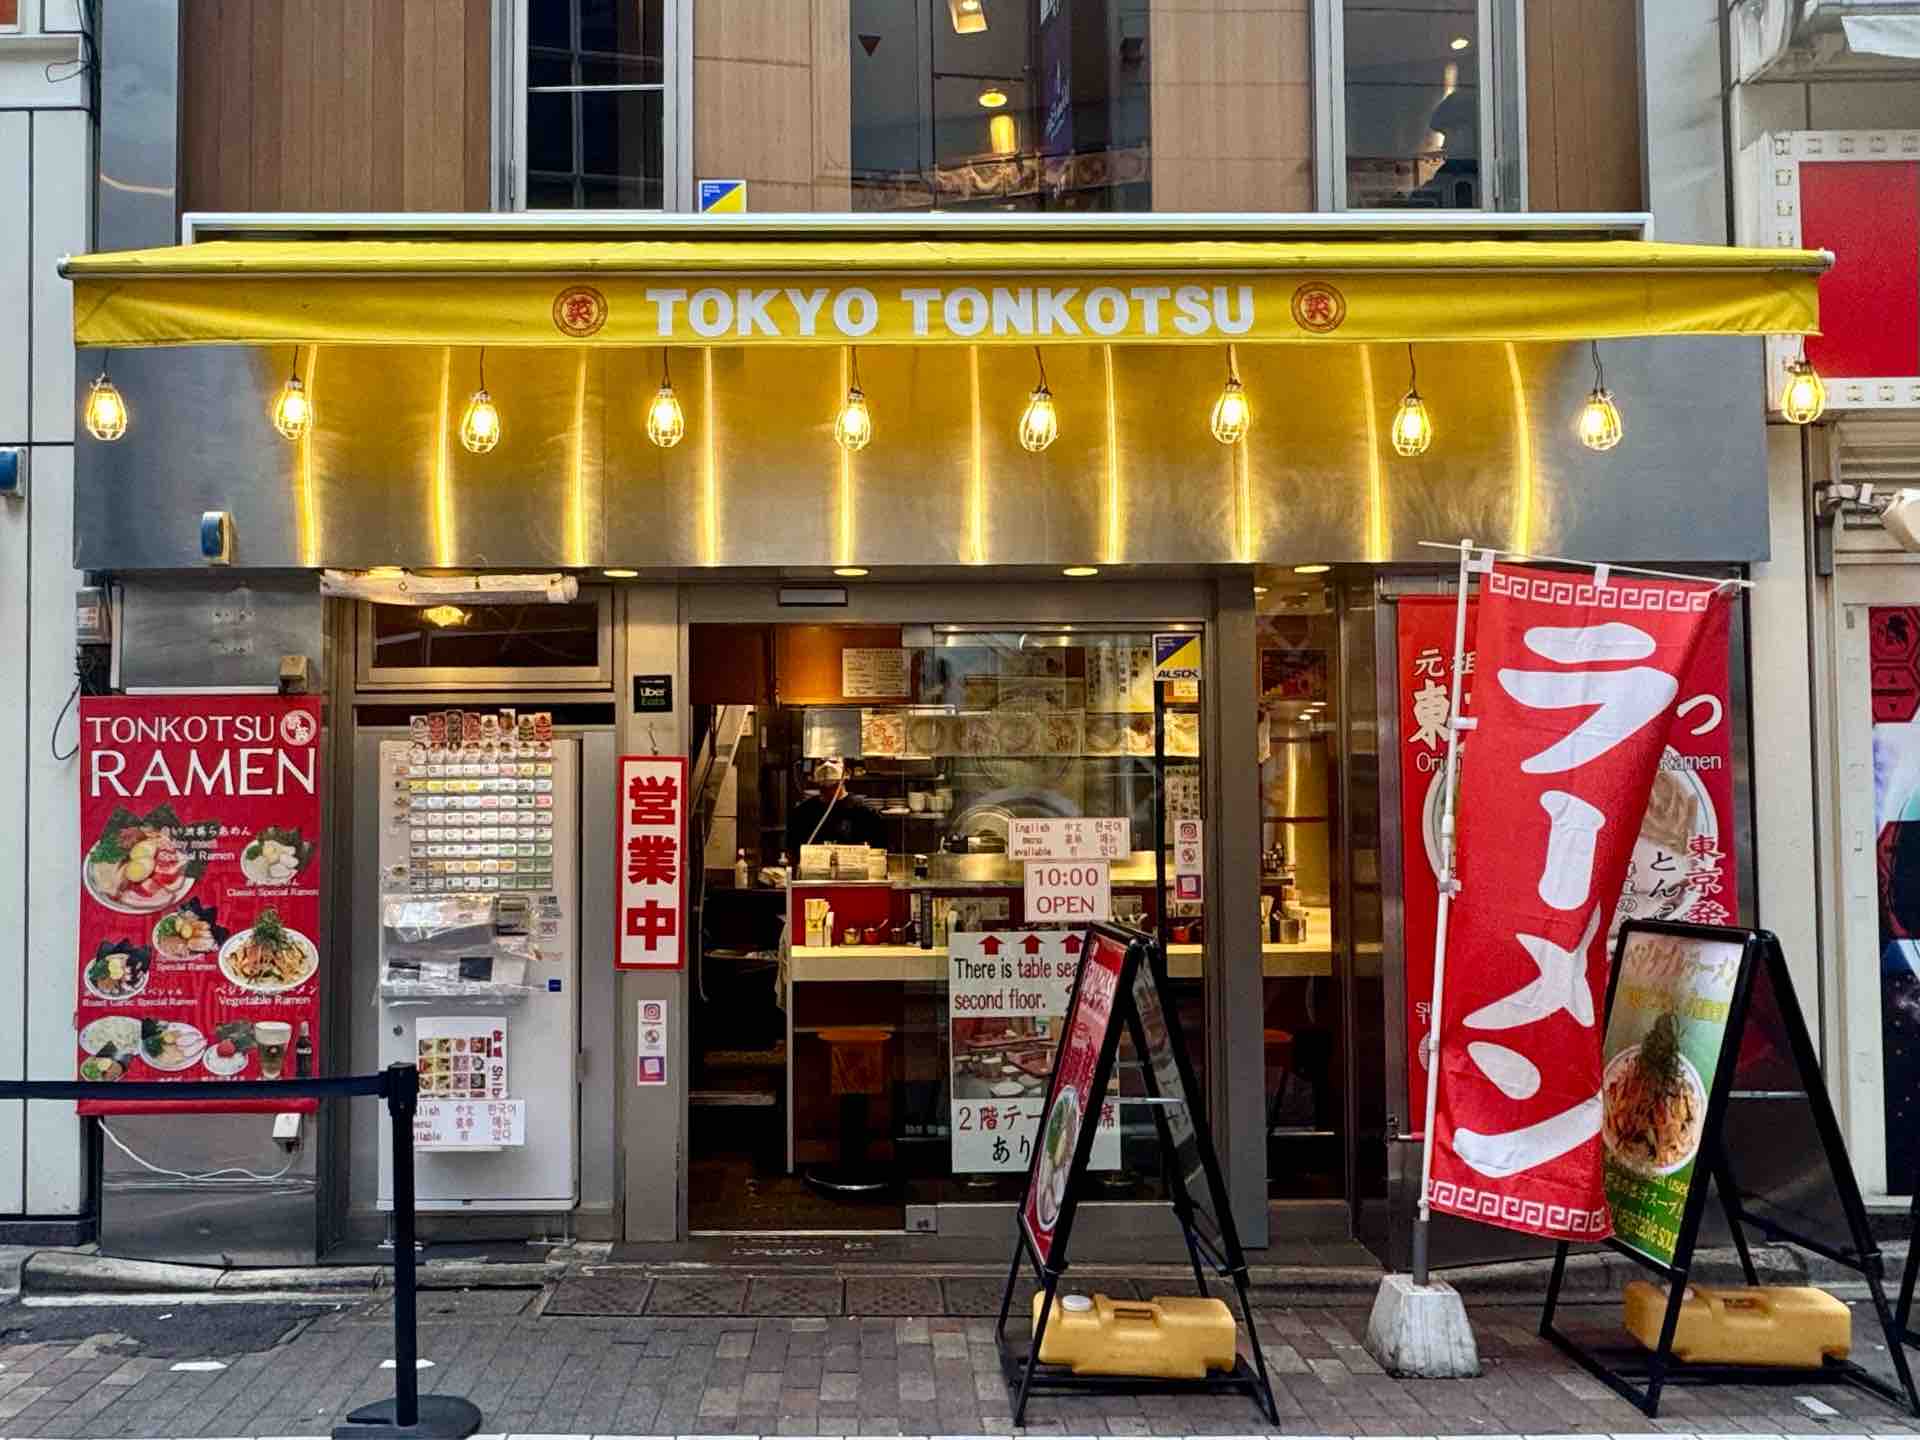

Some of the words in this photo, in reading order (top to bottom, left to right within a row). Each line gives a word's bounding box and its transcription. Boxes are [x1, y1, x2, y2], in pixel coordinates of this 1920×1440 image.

[646, 287, 879, 337] TOKYO
[901, 286, 1254, 336] TONKOTSU
[1157, 669, 1199, 679] ALSOK
[640, 687, 667, 697] Uber
[86, 715, 275, 743] TONKOTSU
[1660, 752, 1722, 770] Ramen
[91, 747, 316, 797] RAMEN
[1015, 823, 1050, 833] English
[1064, 822, 1083, 833] 中文
[1095, 821, 1122, 832] 한국어
[1022, 836, 1042, 844] menu
[1015, 847, 1051, 856] available
[626, 775, 678, 952] 営業中
[1035, 867, 1098, 886] 10:00
[1036, 896, 1096, 914] OPEN
[1452, 622, 1679, 1178] ラーメン
[954, 957, 996, 979] There
[1001, 958, 1013, 978] is
[1018, 956, 1051, 978] table
[219, 996, 272, 1007] Vegetable
[275, 995, 310, 1005] Ramen
[954, 990, 1003, 1009] second
[1008, 988, 1046, 1009] floor.
[488, 1104, 517, 1116] 한국어
